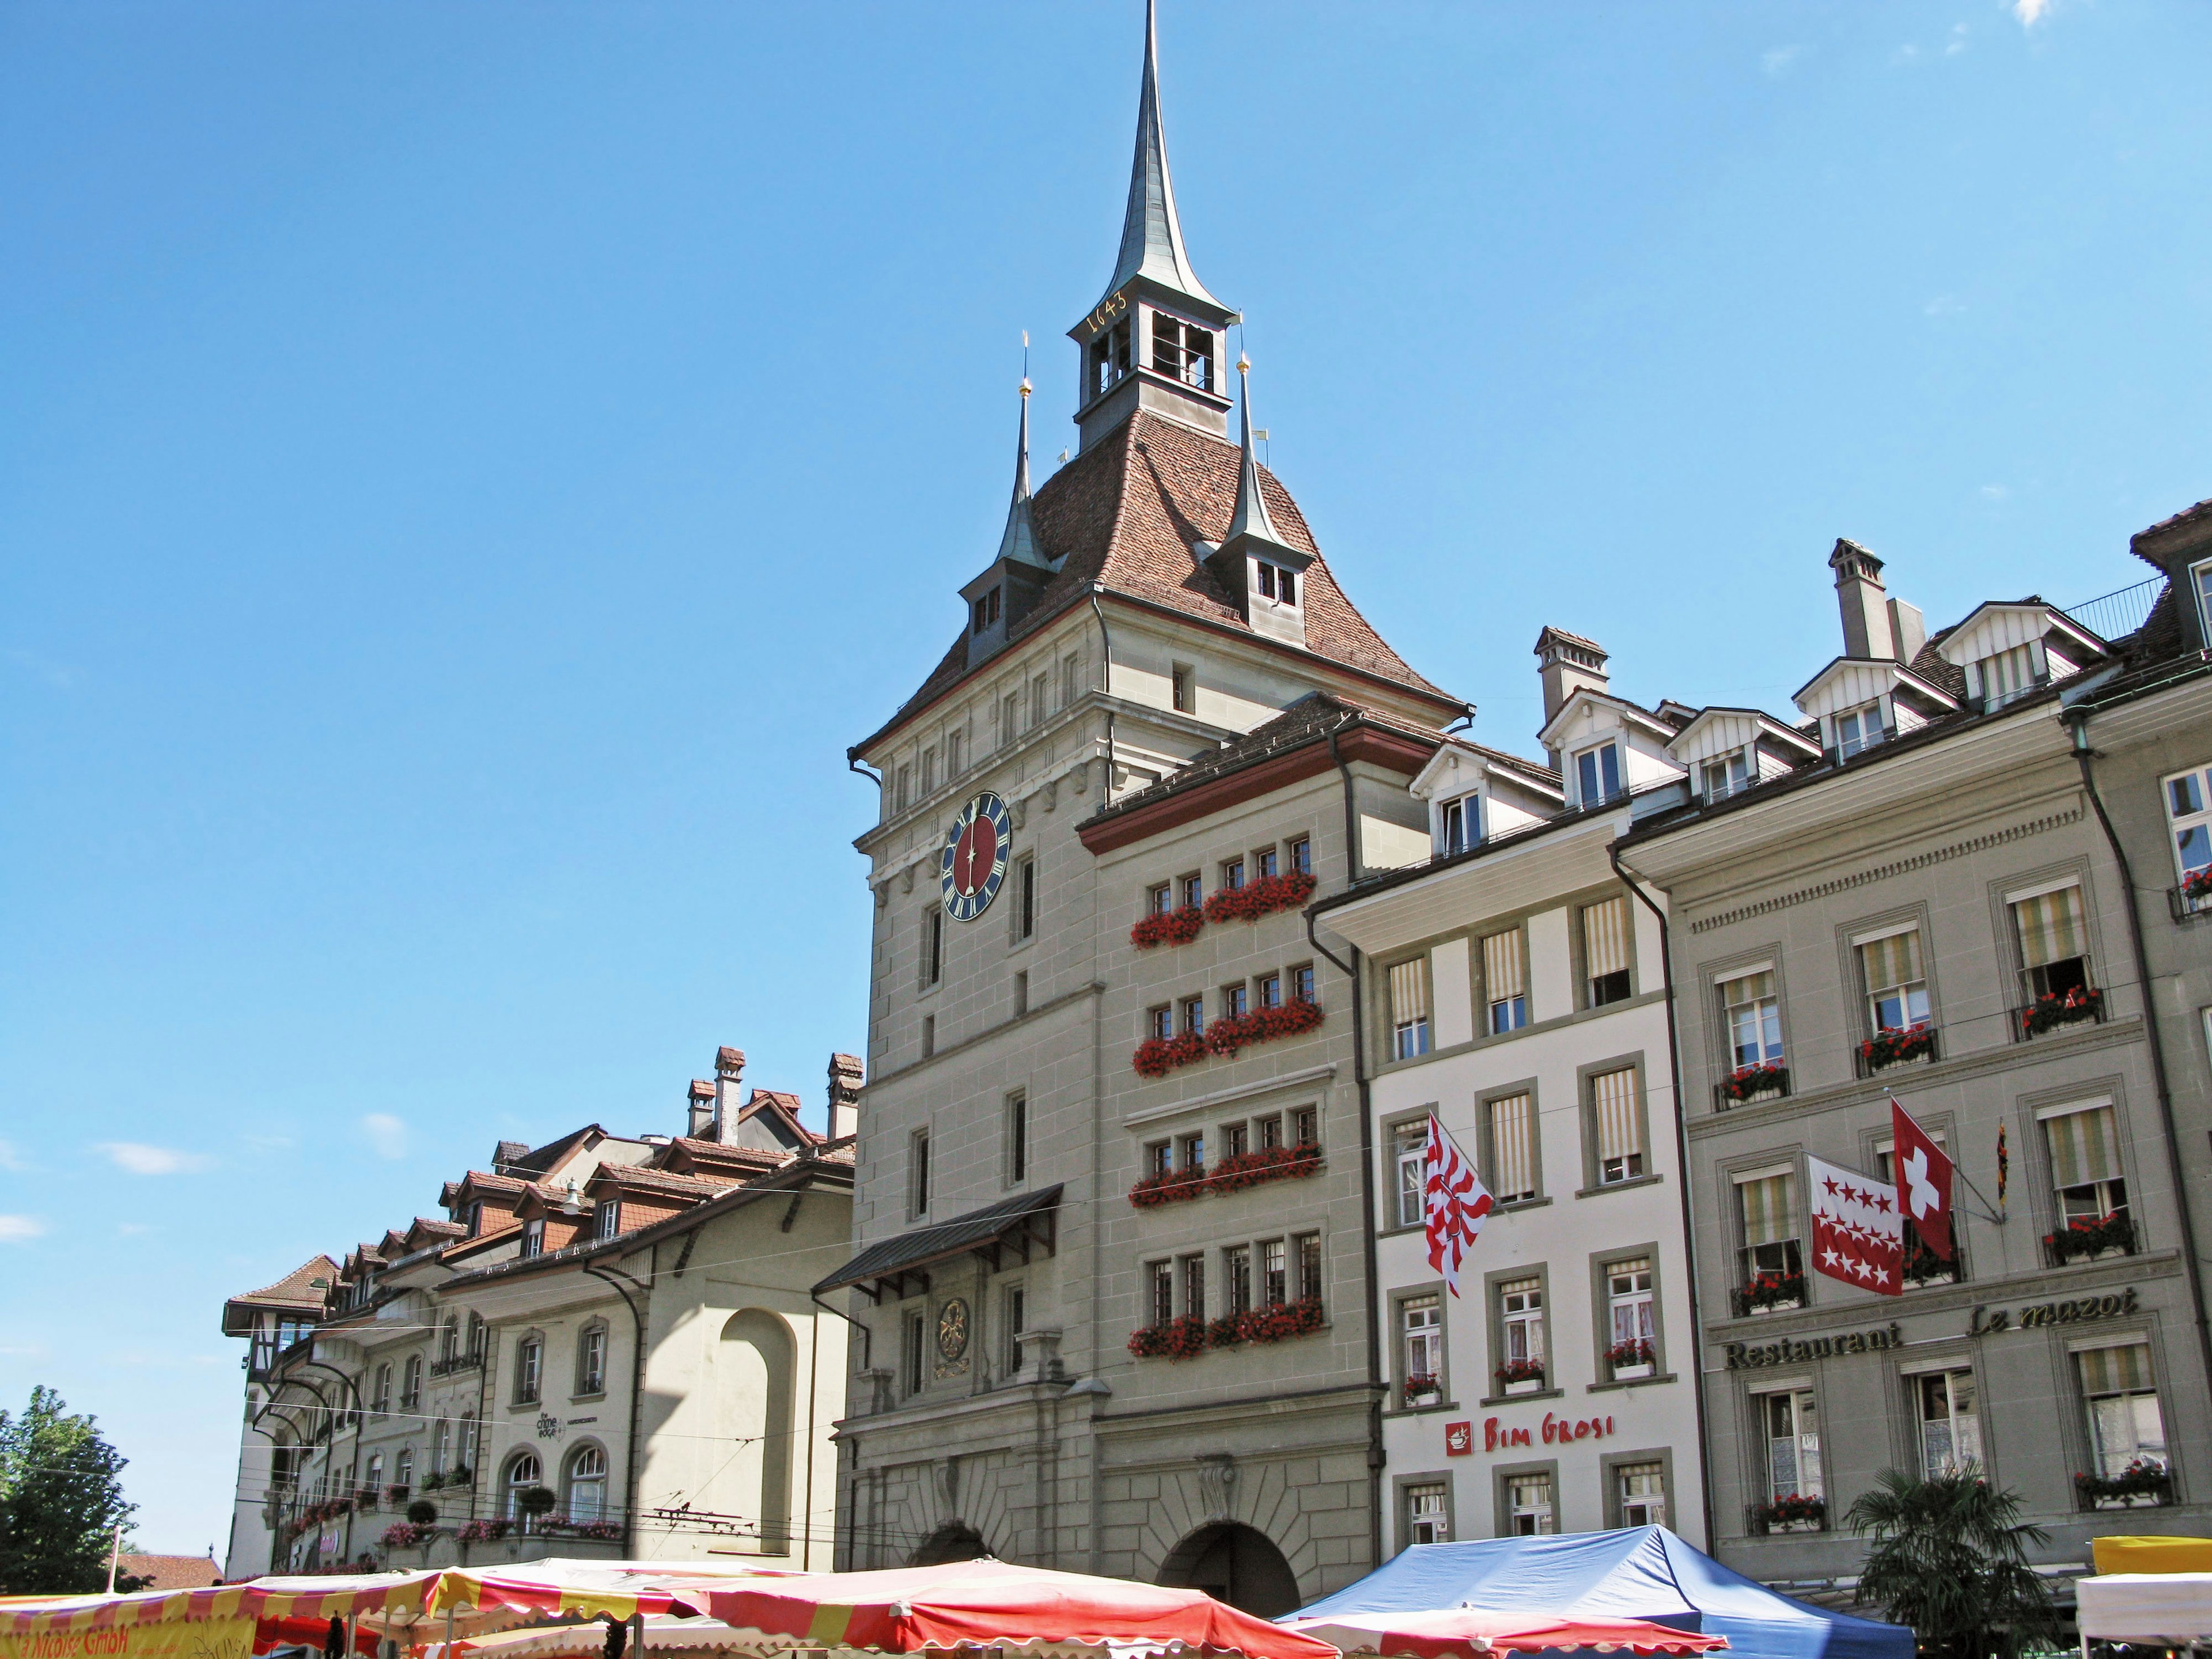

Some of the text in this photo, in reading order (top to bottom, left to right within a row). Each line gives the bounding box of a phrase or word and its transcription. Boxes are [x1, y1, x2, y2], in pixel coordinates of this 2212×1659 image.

[1086, 290, 1127, 333] 1643
[1965, 1286, 2139, 1336] Le mazot
[1721, 1320, 1904, 1370] Restaurant
[84, 1624, 130, 1656] GmbH
